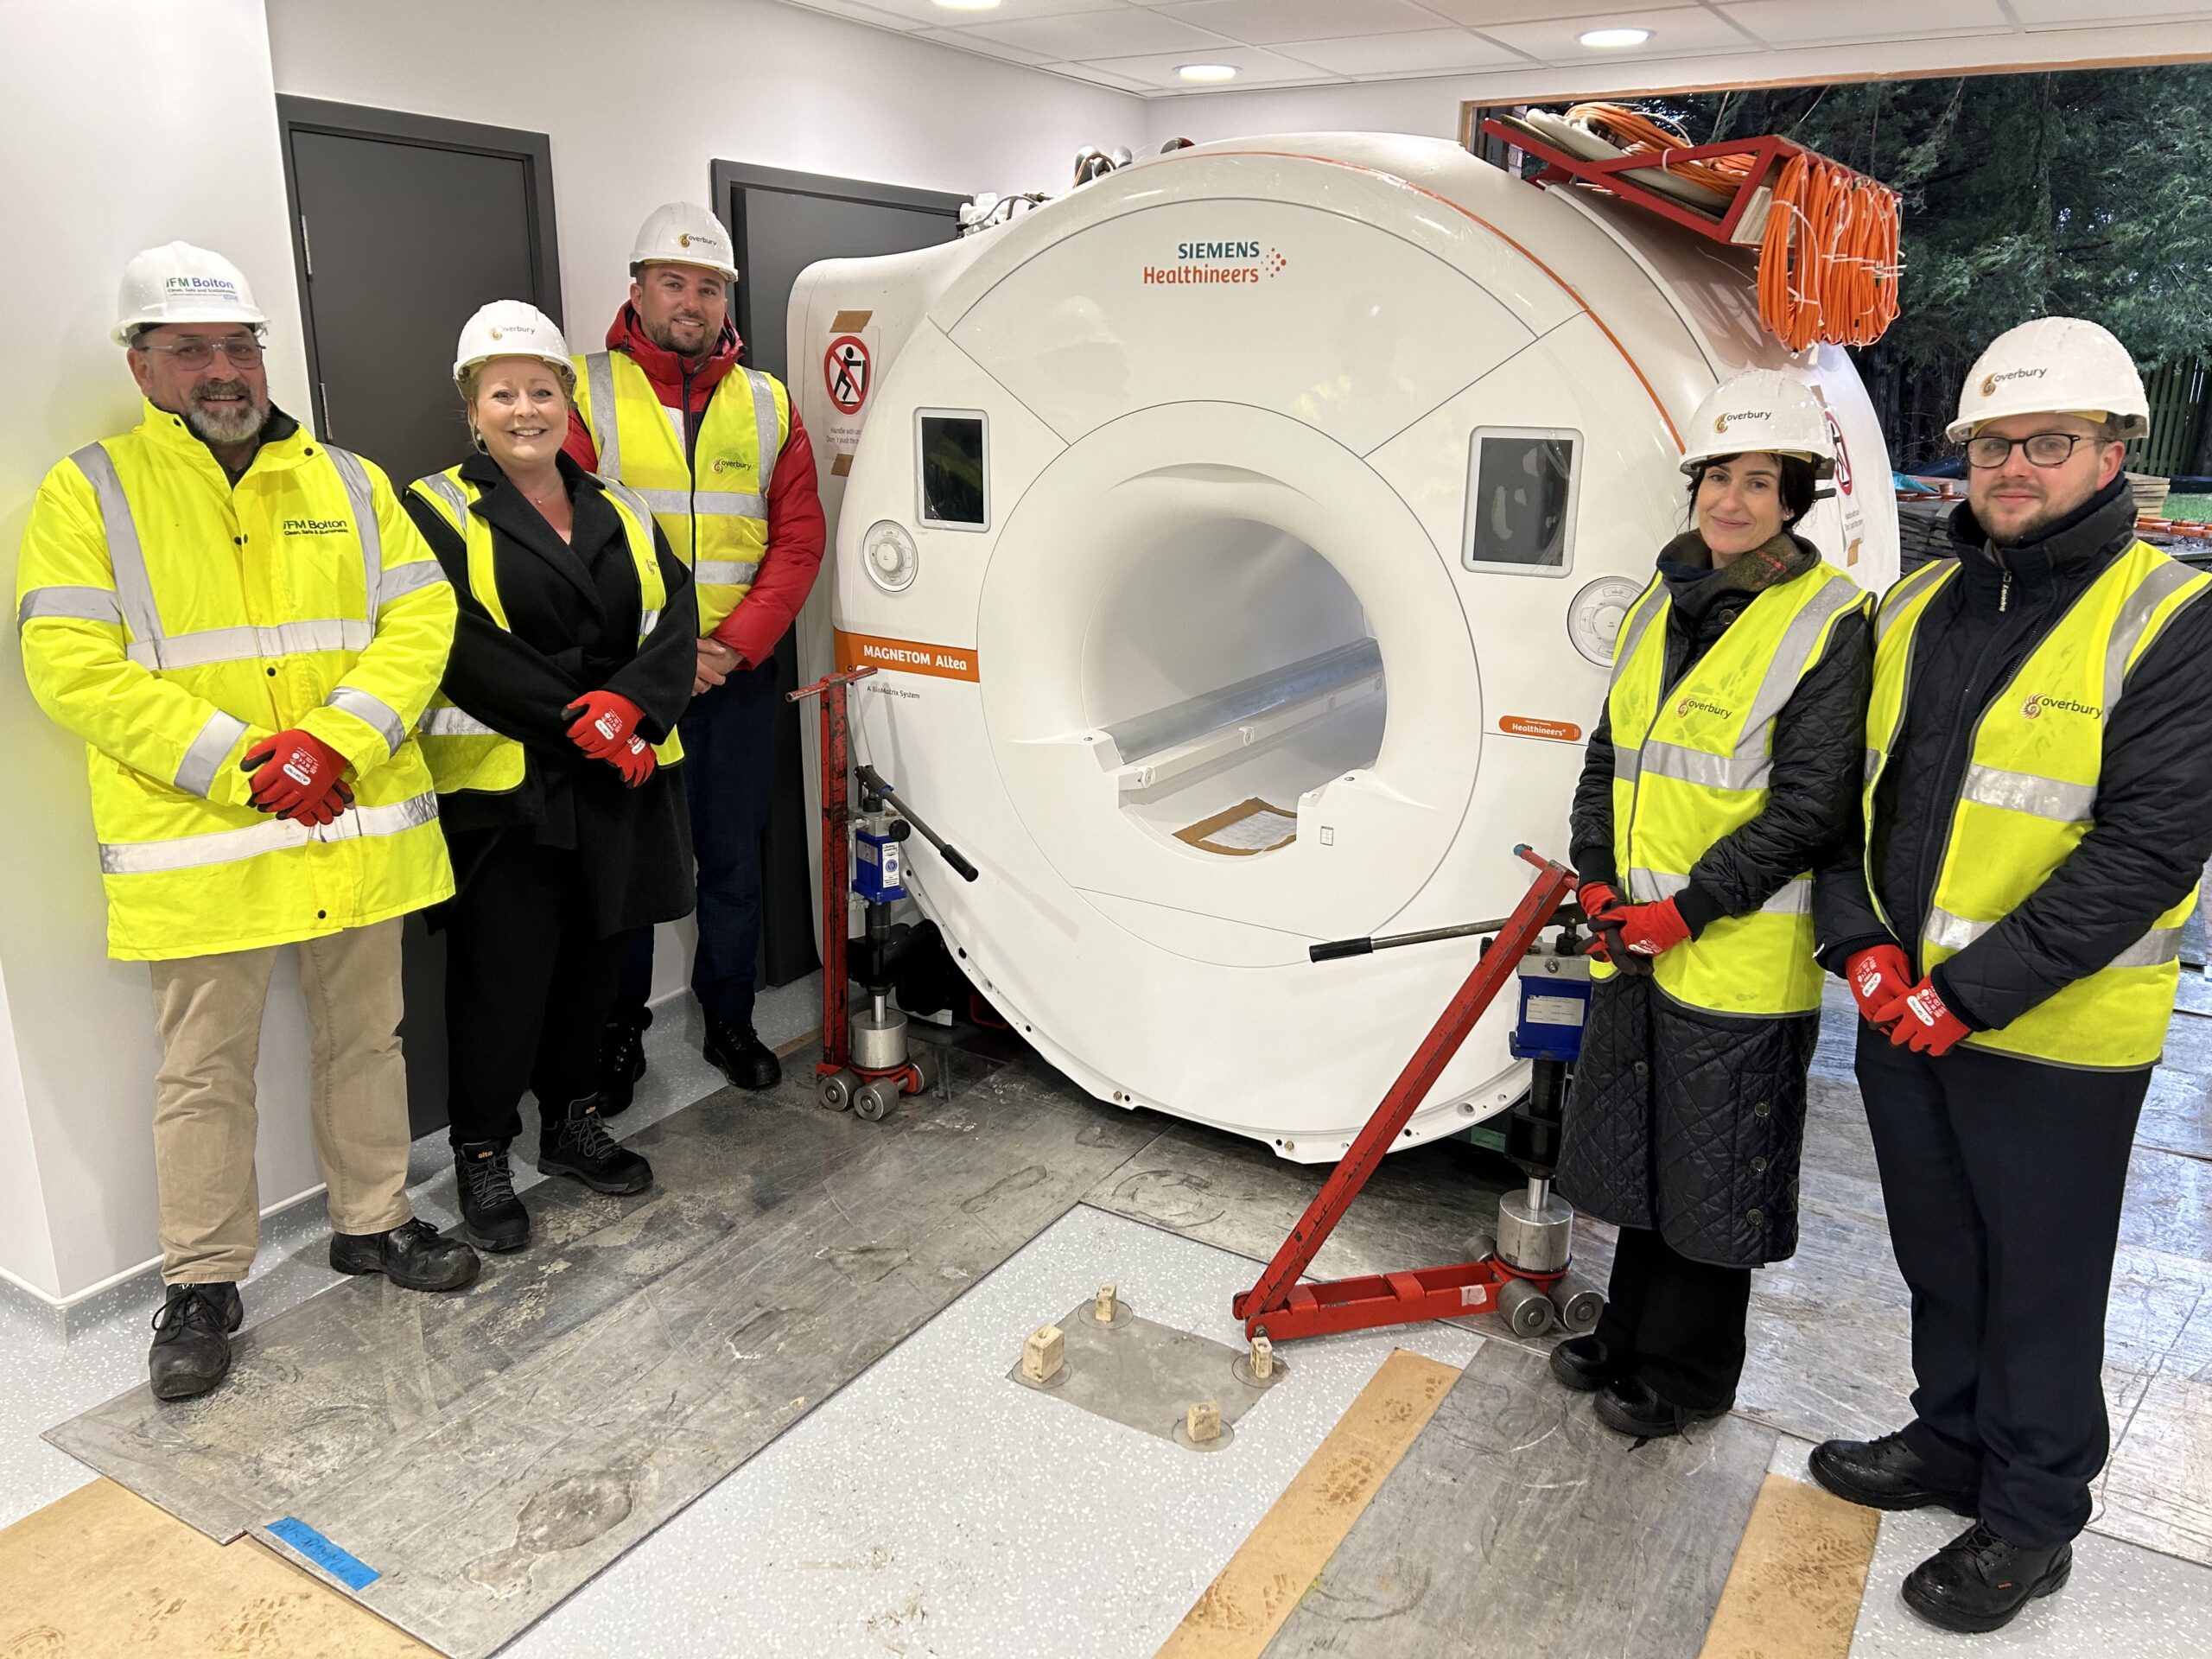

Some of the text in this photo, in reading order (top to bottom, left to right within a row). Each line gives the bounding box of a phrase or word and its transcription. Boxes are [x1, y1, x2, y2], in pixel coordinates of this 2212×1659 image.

[689, 235, 717, 246] overbury
[1178, 241, 1260, 259] SIEMENS
[1143, 264, 1259, 284] Healthineers
[166, 277, 234, 289] iFM Bolton
[1994, 367, 2048, 382] overbury
[1726, 410, 1772, 422] overbury
[721, 460, 752, 471] overbury
[283, 519, 347, 530] iFM Bolton
[863, 645, 967, 671] MAGNETOM Altea
[872, 686, 899, 696] BioMatrix
[899, 690, 920, 699] System
[1688, 700, 1732, 720] overbury
[2041, 697, 2103, 720] overbury
